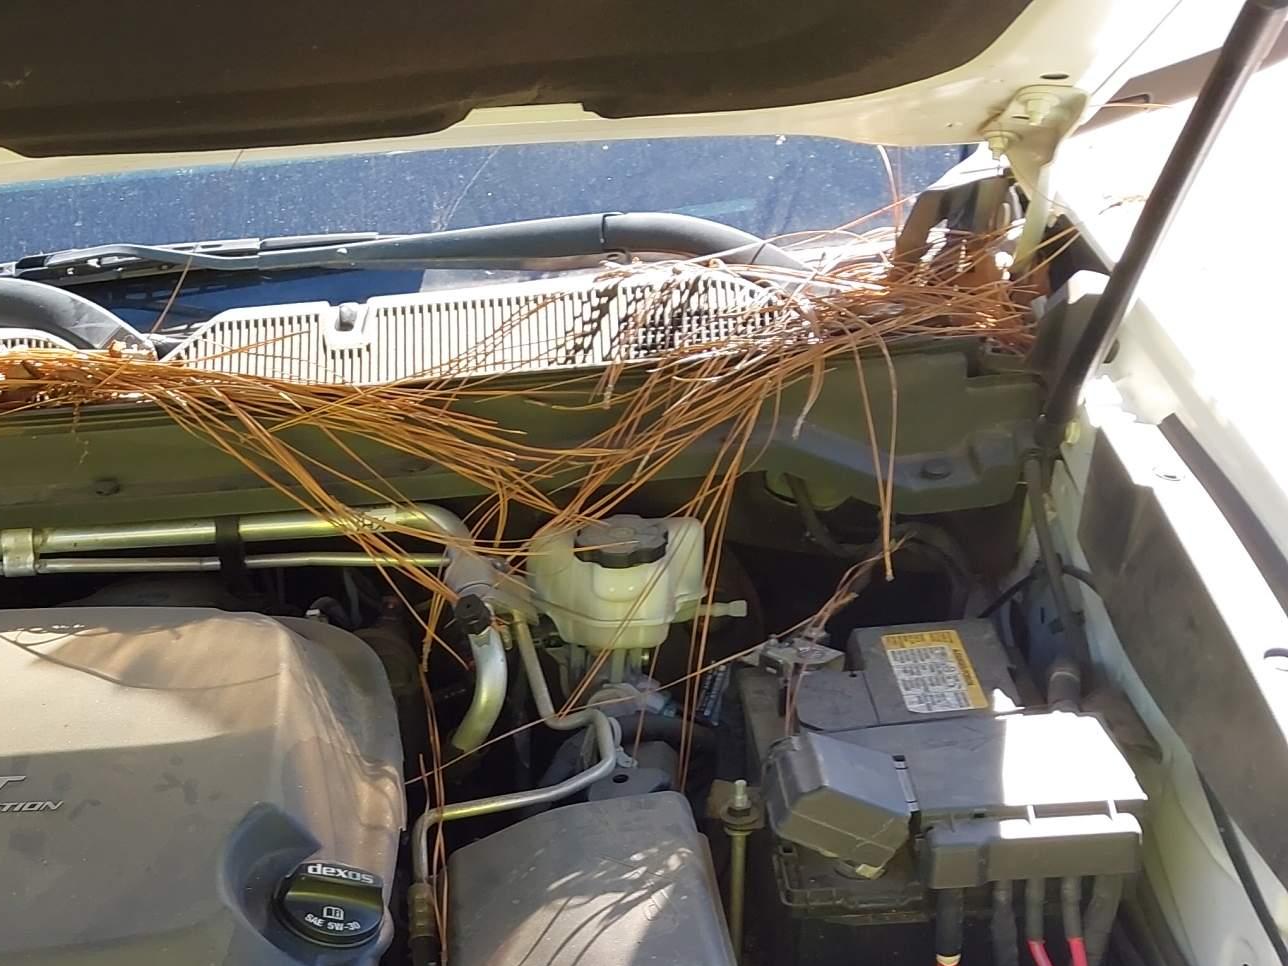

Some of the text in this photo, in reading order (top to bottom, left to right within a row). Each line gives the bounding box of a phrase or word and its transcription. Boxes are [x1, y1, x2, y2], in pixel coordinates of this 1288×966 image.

[307, 863, 373, 884] dexos
[304, 913, 361, 931] SAE 5W-30
